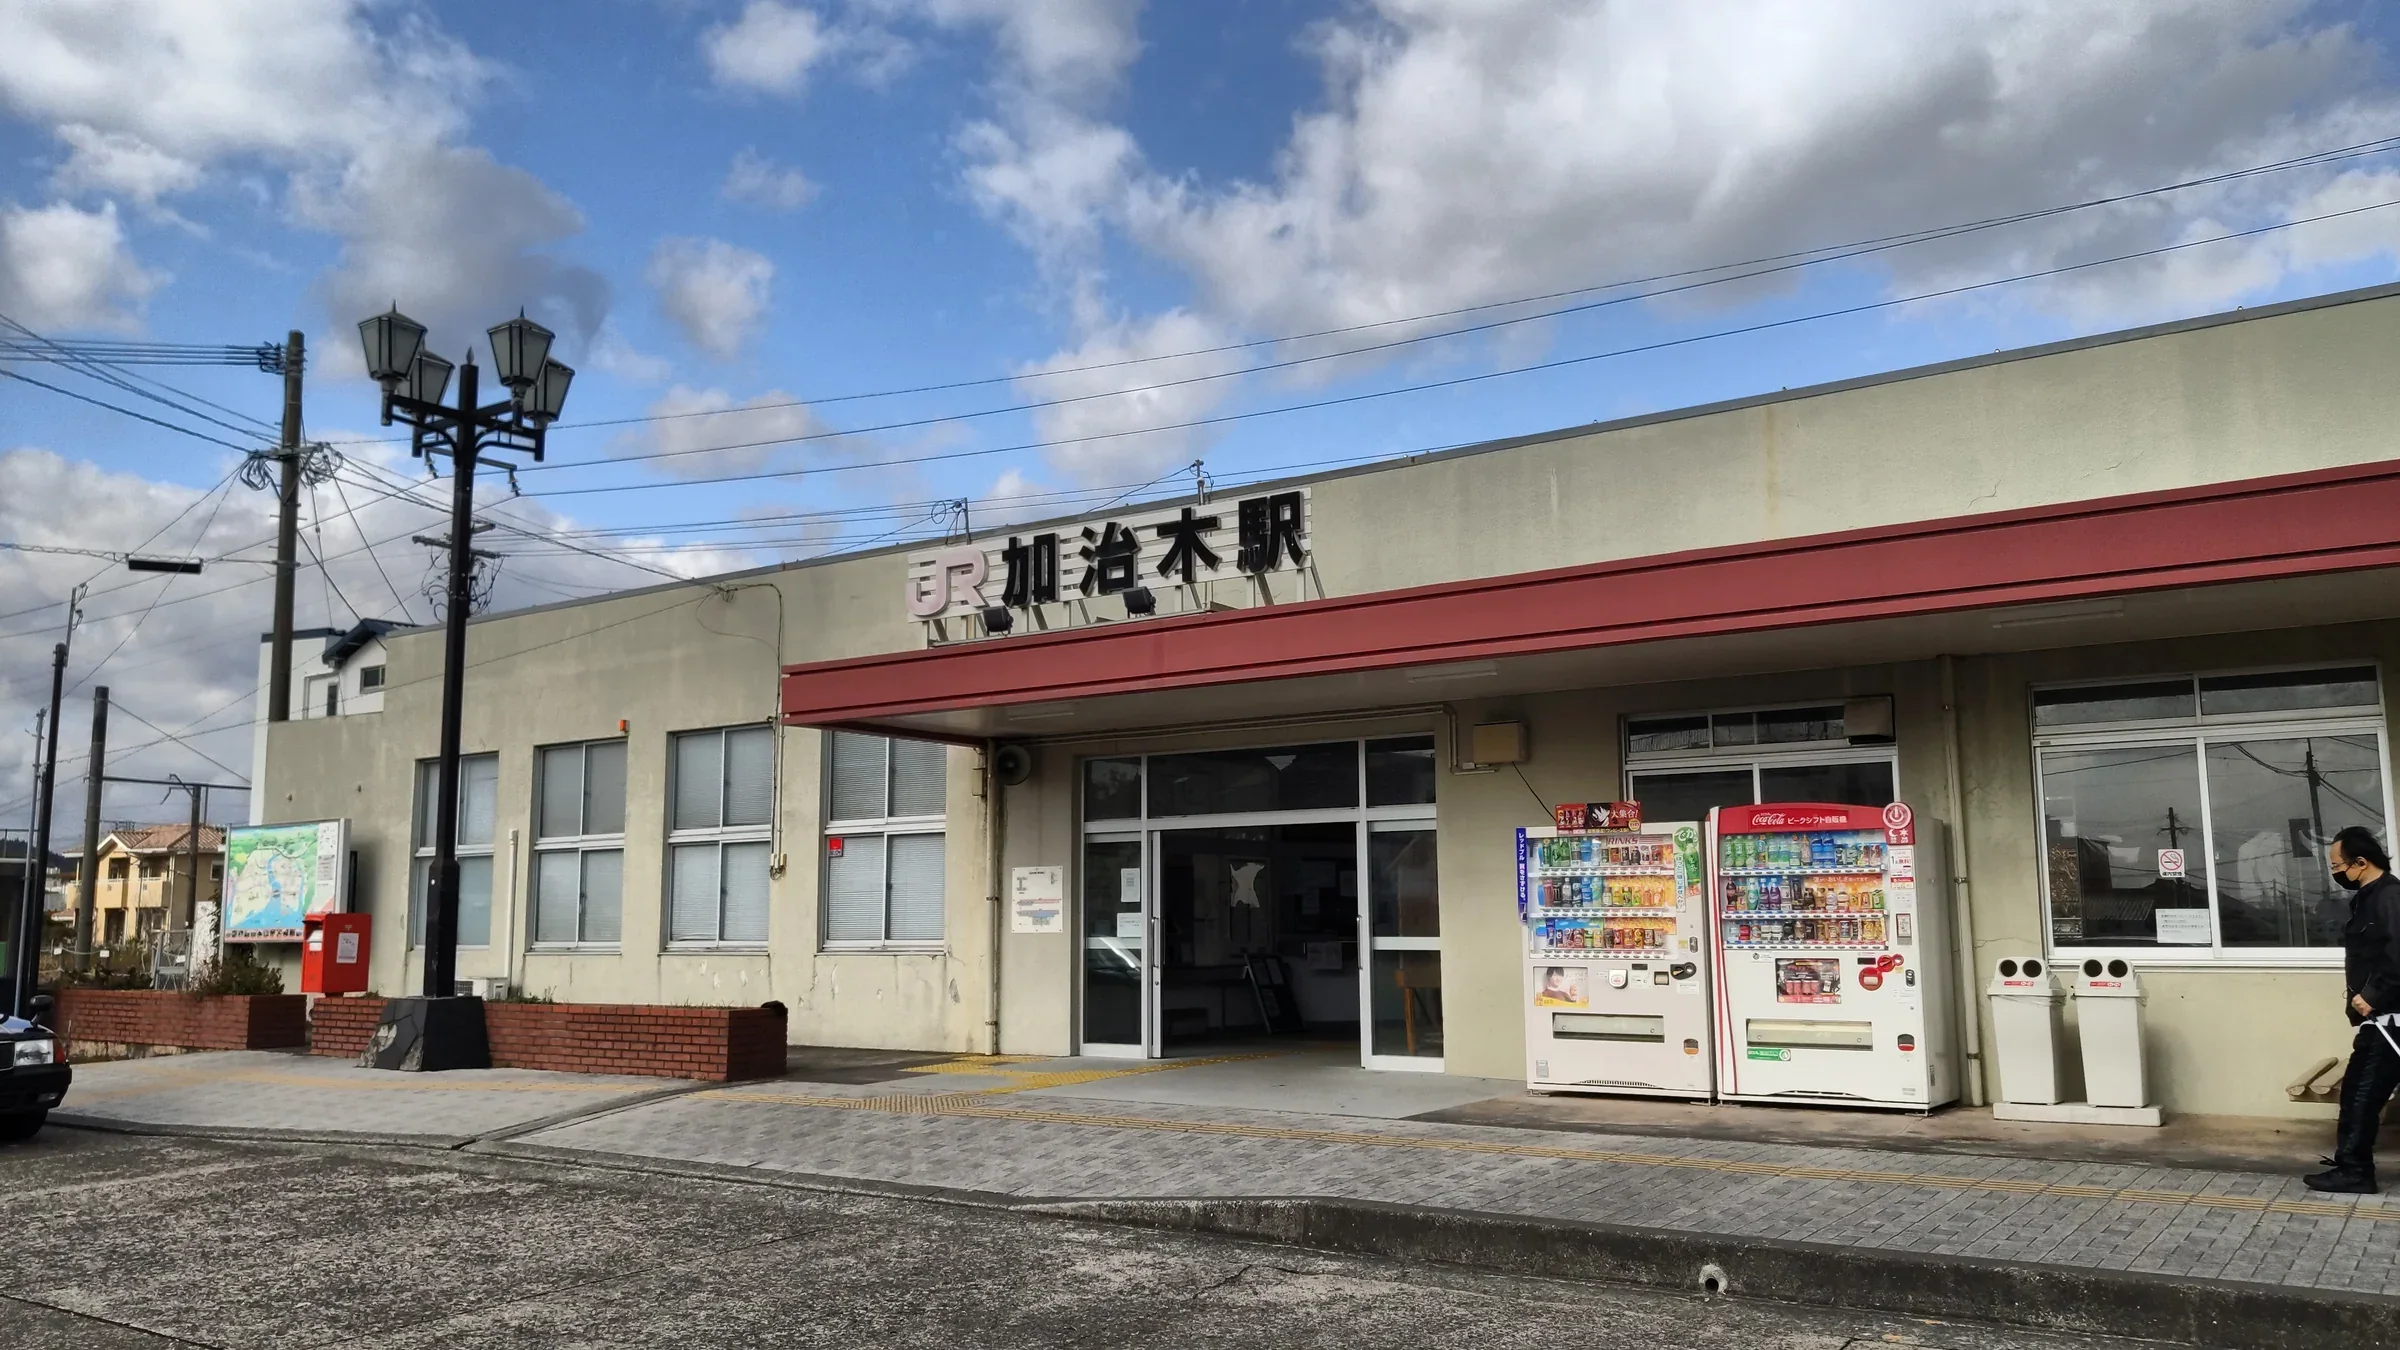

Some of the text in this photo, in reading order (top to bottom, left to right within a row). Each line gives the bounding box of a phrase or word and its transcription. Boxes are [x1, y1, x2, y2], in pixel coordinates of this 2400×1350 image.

[907, 490, 1308, 617] JR 加治木駅
[1752, 813, 1787, 826] Coca-Cola
